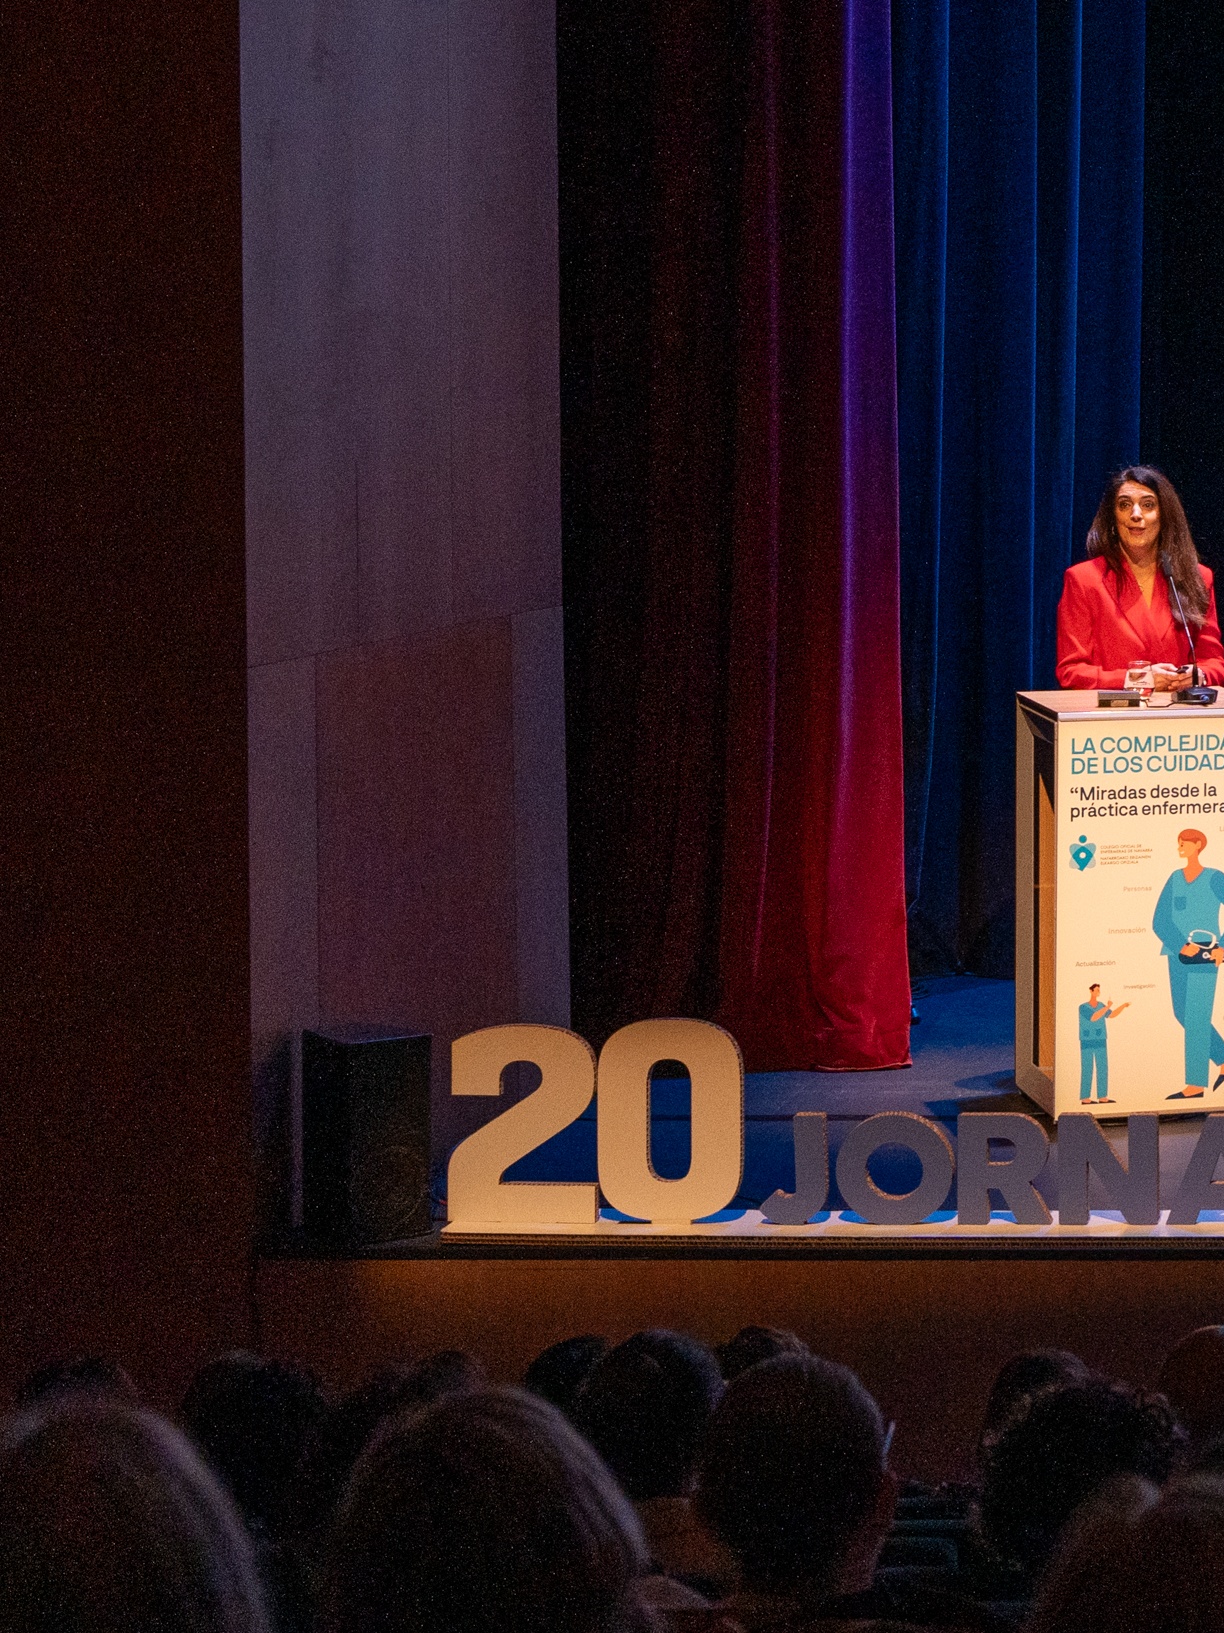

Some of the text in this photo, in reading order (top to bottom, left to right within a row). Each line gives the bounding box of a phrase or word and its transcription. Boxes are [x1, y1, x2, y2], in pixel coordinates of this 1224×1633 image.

[1071, 738, 1096, 754] LA
[1071, 757, 1098, 774] DE
[1103, 756, 1143, 774] LOS
[1150, 784, 1200, 799] desde
[1204, 783, 1217, 798] la
[1070, 802, 1138, 822] práctica
[1108, 926, 1146, 935] Innovación
[447, 1018, 744, 1225] 20
